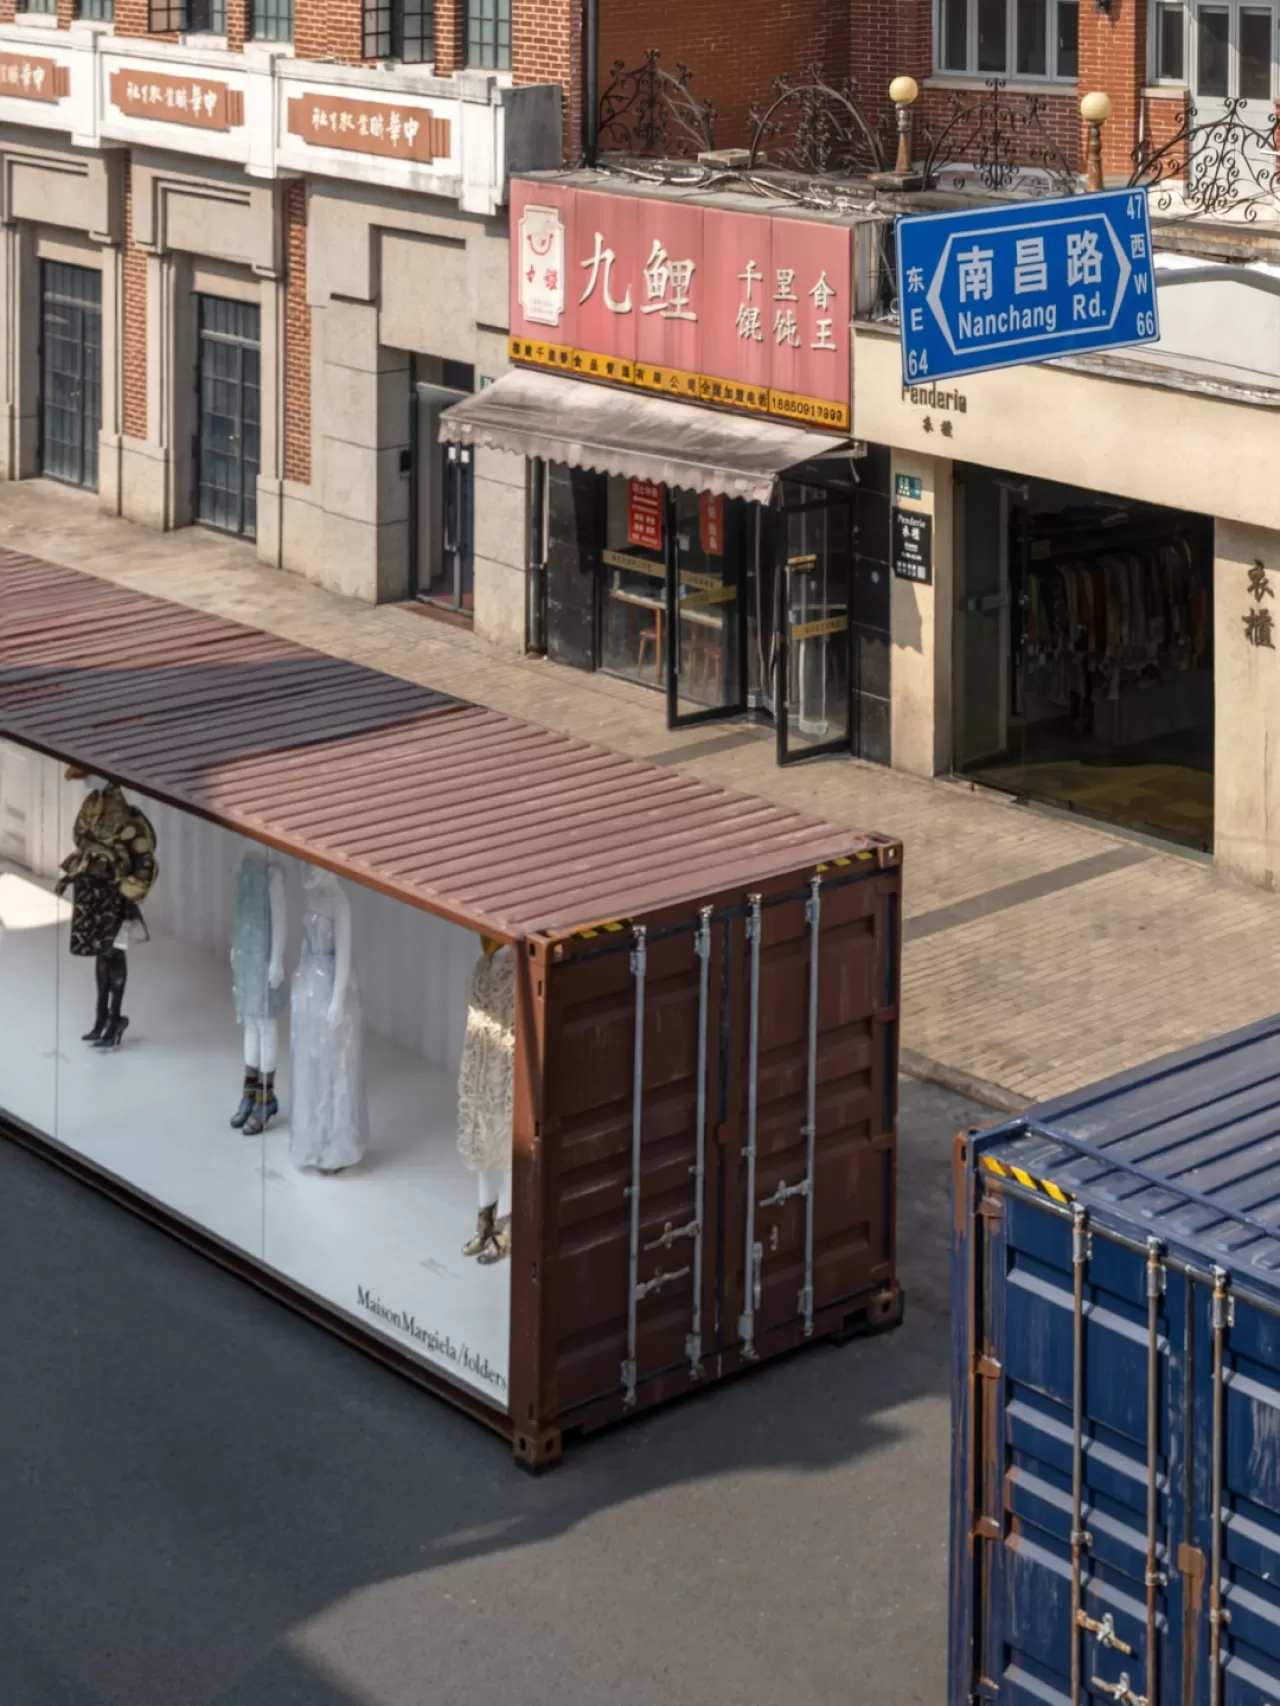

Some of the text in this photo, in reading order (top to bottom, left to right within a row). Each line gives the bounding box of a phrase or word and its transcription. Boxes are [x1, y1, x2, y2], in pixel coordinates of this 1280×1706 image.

[1126, 195, 1143, 220] 47
[1130, 233, 1146, 260] 西
[579, 232, 698, 322] 九鲤
[906, 266, 925, 293] 东
[956, 229, 1103, 303] 南昌路
[737, 259, 837, 311] 千里香
[1134, 272, 1148, 296] W
[736, 302, 838, 351] 馄饨王
[911, 308, 923, 331] E
[958, 291, 1107, 340] Nanchang Rd.
[1137, 311, 1154, 337] 66
[909, 349, 929, 376] 64
